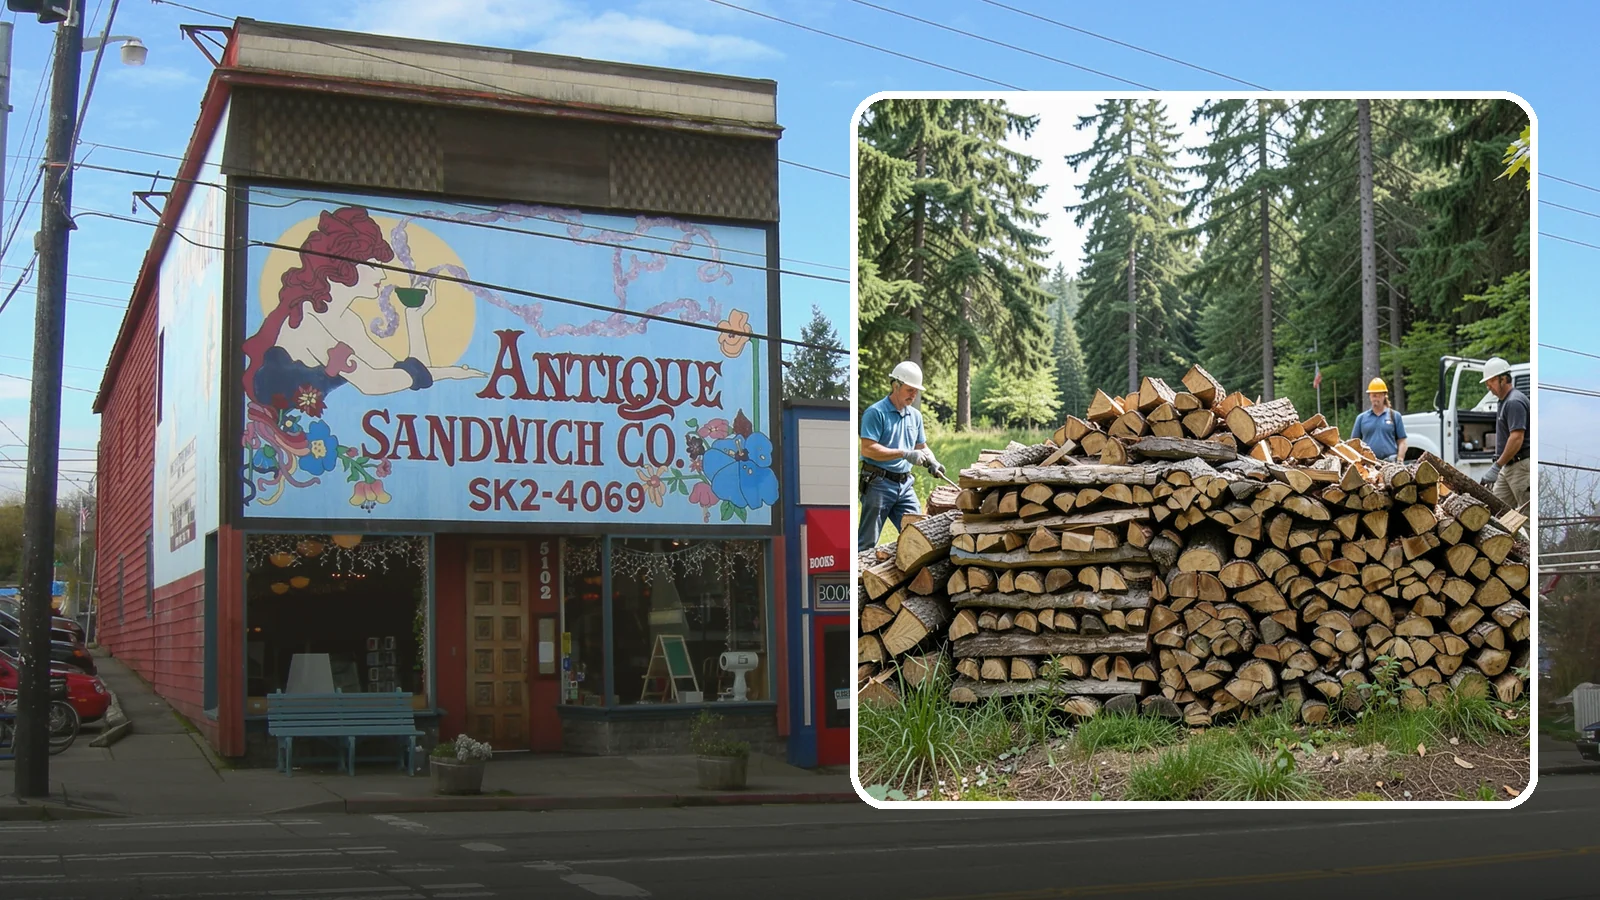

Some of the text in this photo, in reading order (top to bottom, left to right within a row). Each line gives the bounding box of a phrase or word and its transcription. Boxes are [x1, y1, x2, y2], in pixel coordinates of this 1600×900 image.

[475, 328, 724, 421] ANTIQUE
[361, 408, 685, 468] SANDWICH CO.
[468, 476, 646, 513] SK2-4069
[540, 541, 552, 600] 5102
[809, 555, 835, 569] BOOKS
